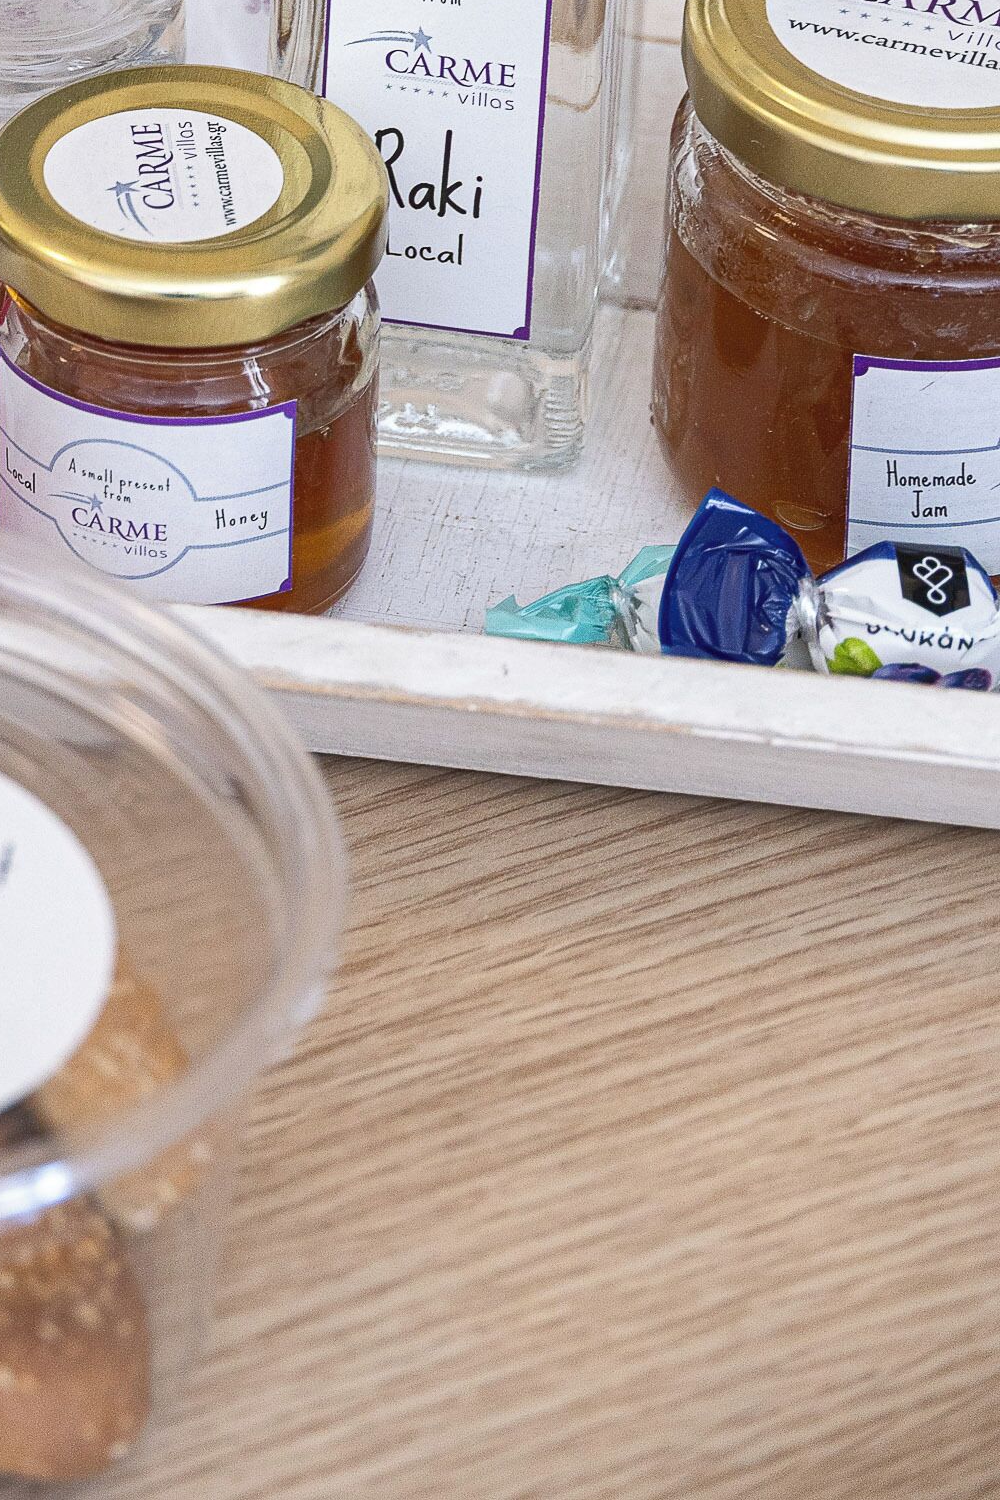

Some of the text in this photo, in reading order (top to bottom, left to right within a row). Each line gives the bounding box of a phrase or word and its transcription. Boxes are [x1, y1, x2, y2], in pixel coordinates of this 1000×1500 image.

[384, 49, 517, 89] CARME
[457, 91, 515, 112] villas
[176, 121, 197, 160] villas
[130, 122, 174, 210] CARME
[205, 121, 236, 227] www.carmevillas.gr
[374, 127, 484, 219] Raki
[385, 234, 464, 266] Local
[5, 447, 36, 494] Local
[68, 458, 171, 494] A small present
[886, 460, 976, 488] Homemade
[103, 485, 132, 504] from
[911, 490, 948, 518] Jam
[71, 507, 168, 542] CARME
[216, 508, 269, 531] Honey
[124, 544, 168, 559] villas
